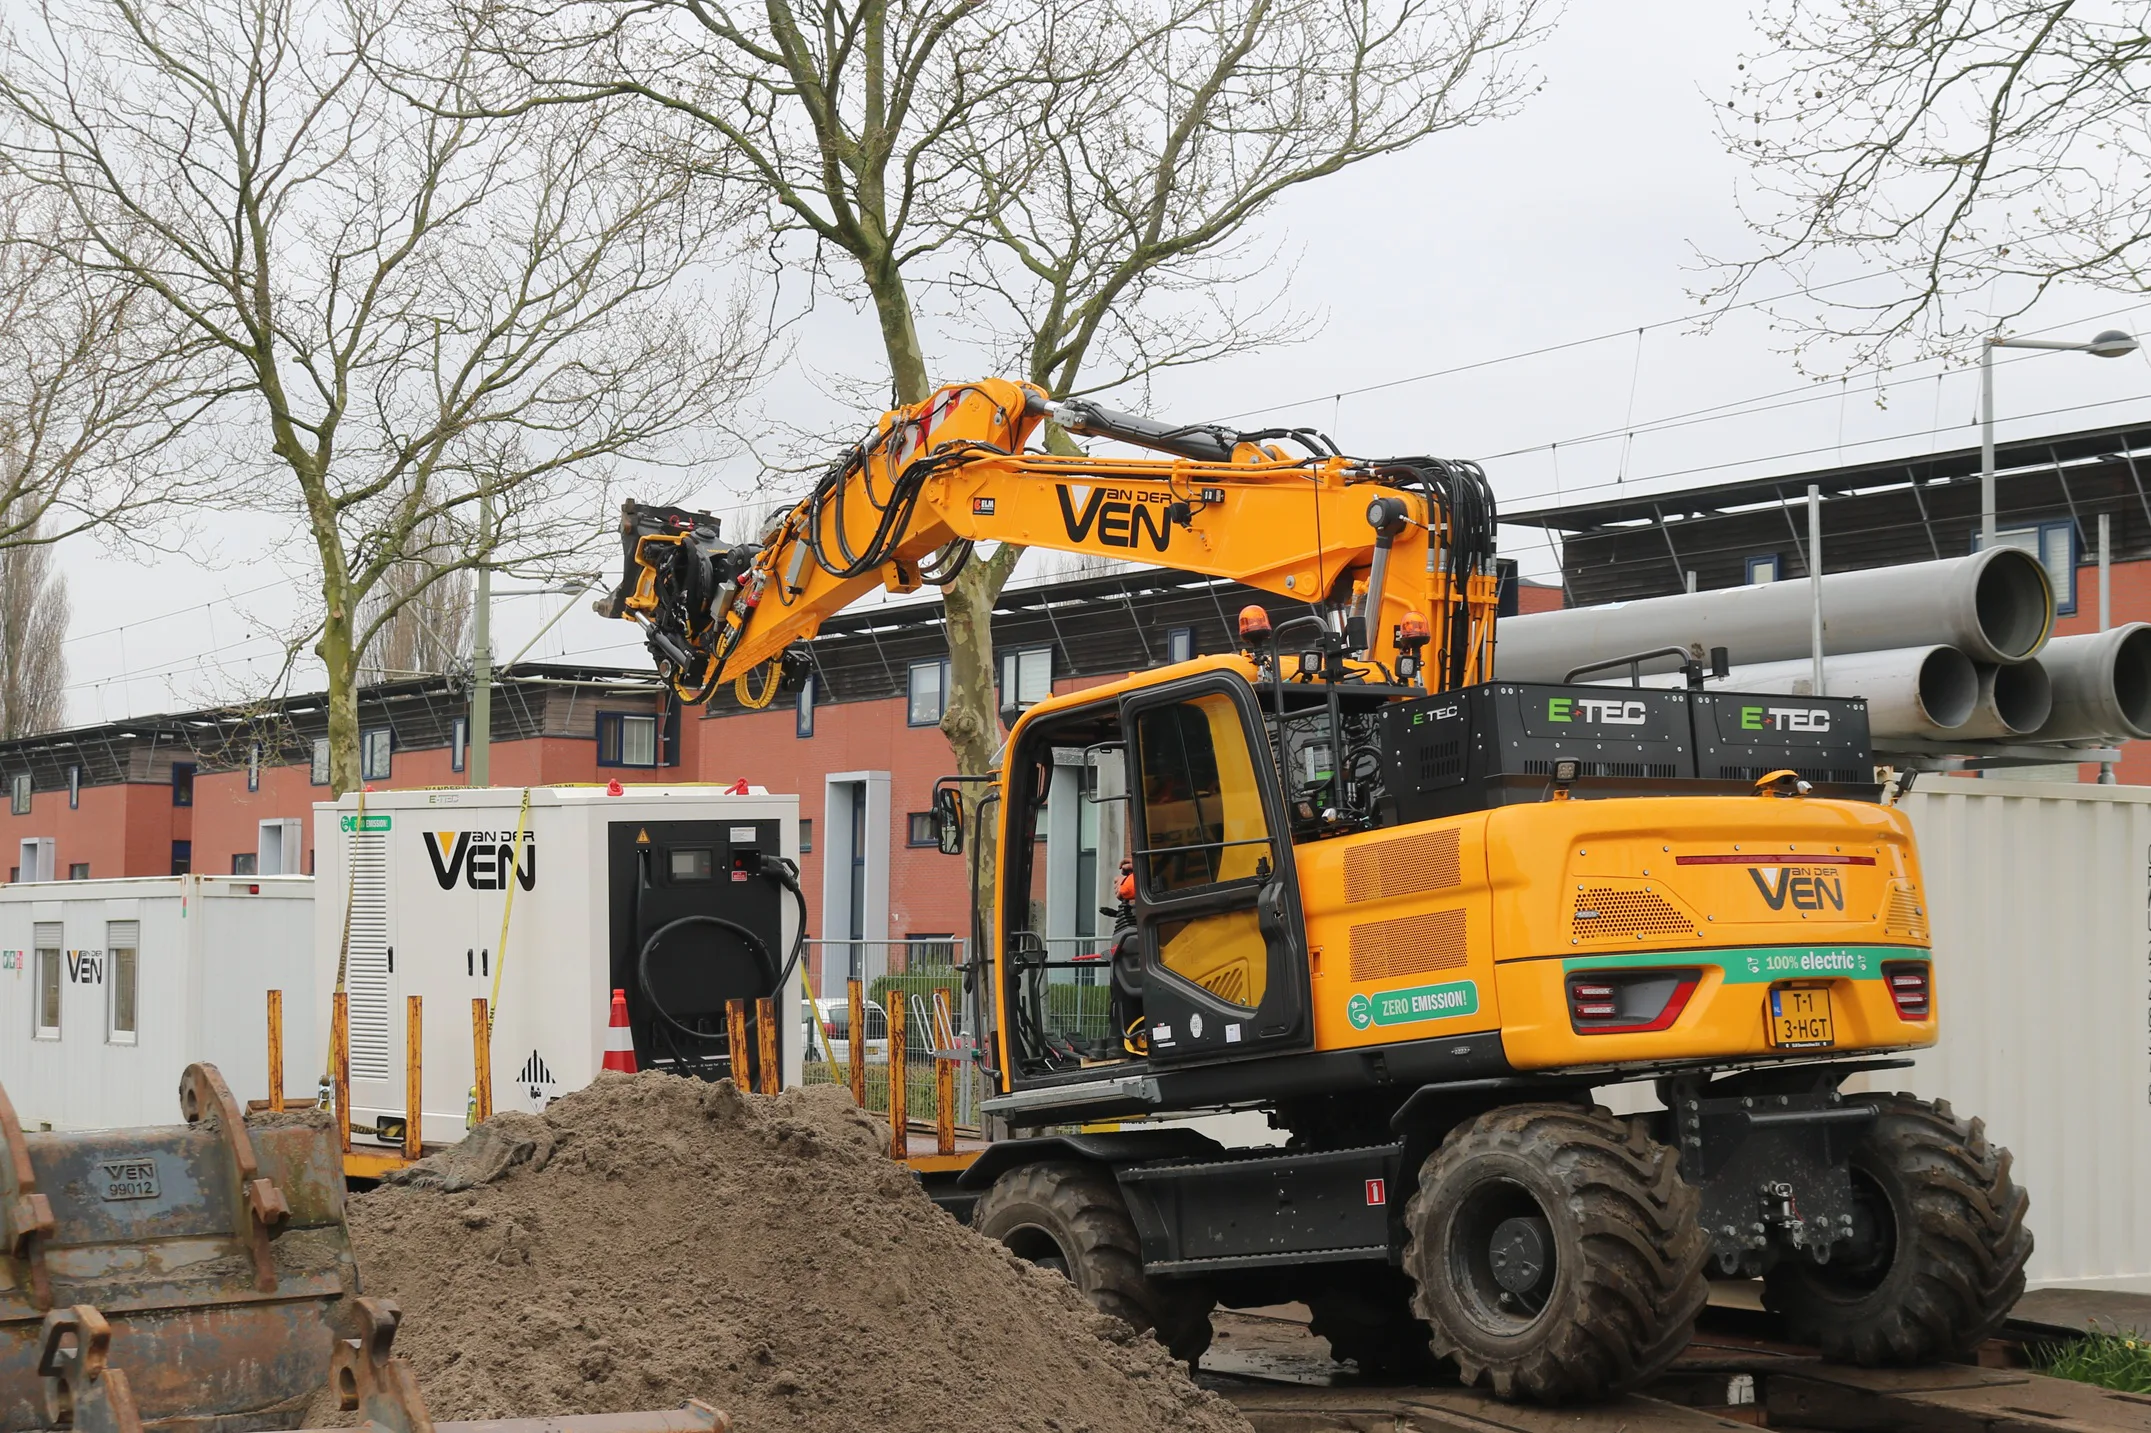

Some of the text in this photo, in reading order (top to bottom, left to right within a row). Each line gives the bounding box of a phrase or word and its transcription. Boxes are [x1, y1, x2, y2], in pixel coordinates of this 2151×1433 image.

[1055, 484, 1171, 552] VEN
[422, 831, 536, 892] VEN
[1747, 867, 1844, 911] VEN
[66, 950, 103, 985] VEN
[1766, 950, 1855, 970] 100% electric
[1381, 990, 1468, 1017] ZERO EMISSION!
[1784, 1018, 1827, 1039] 3-HGT
[103, 1164, 154, 1181] VEN
[109, 1181, 153, 1196] 99012
